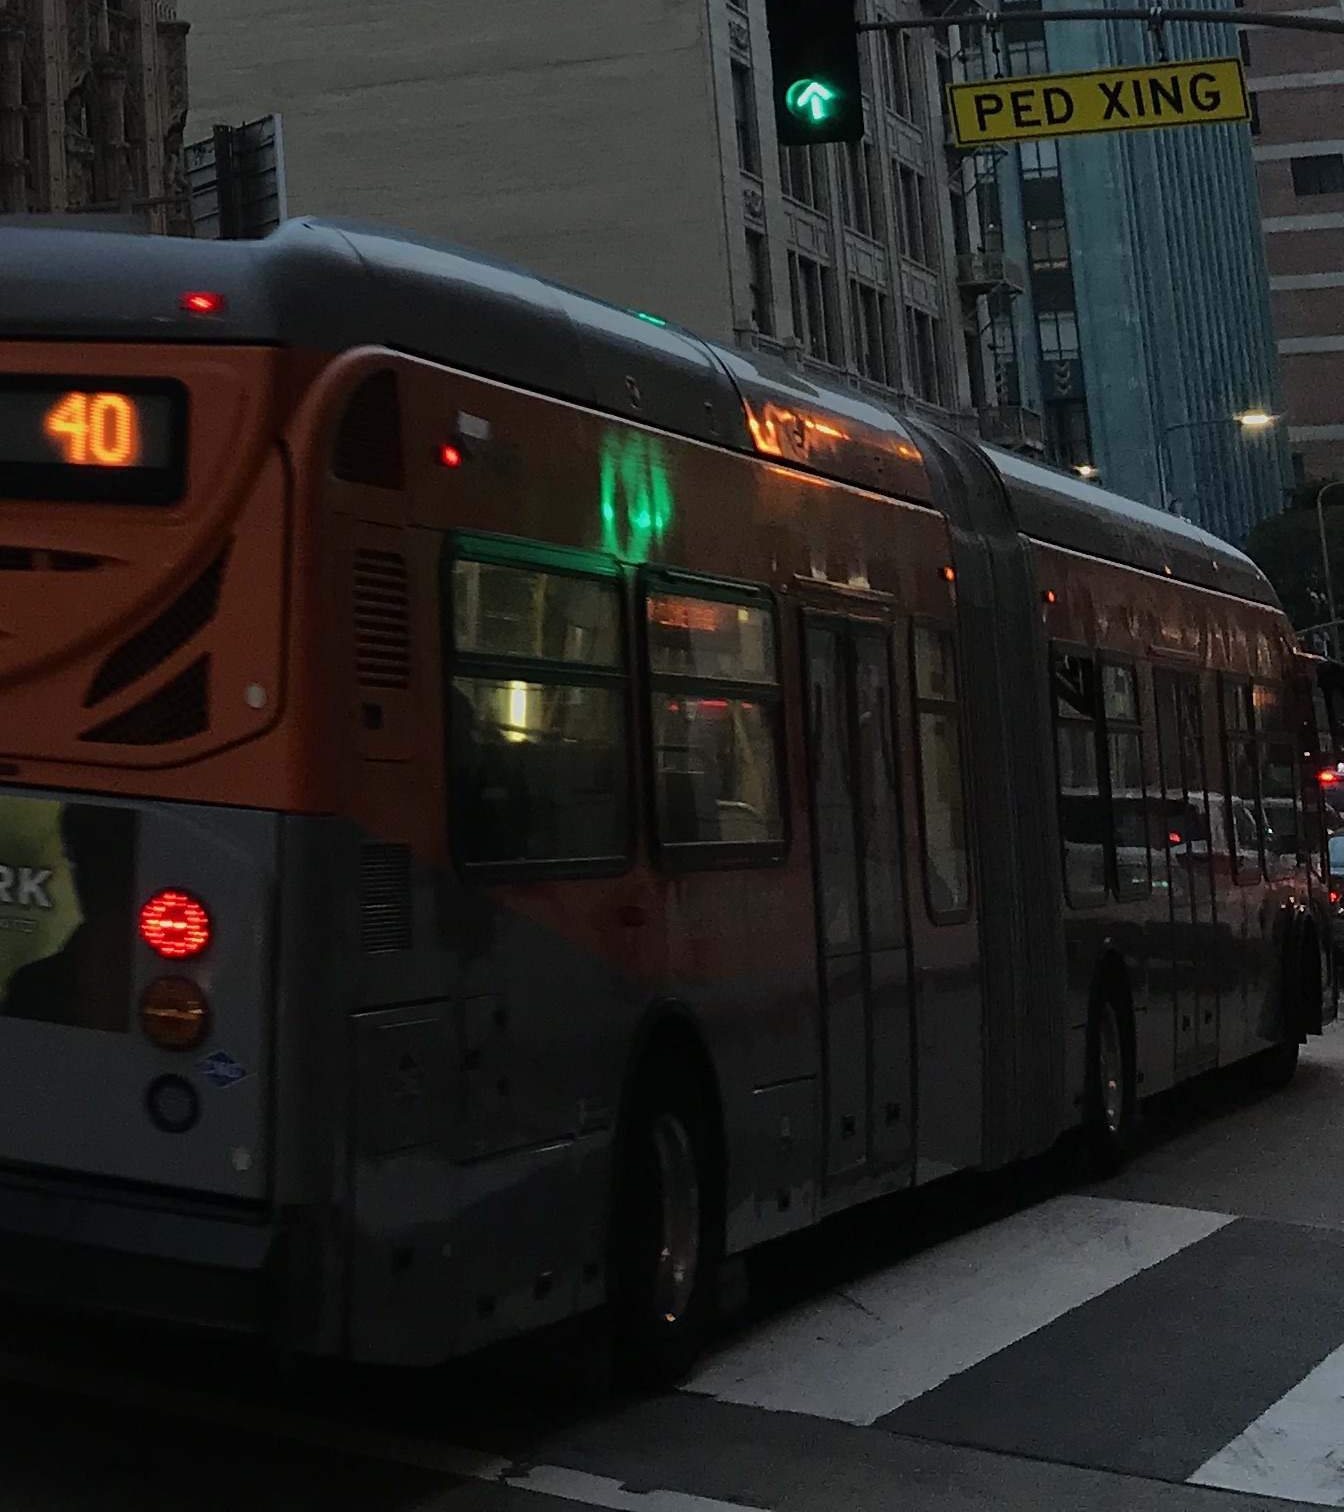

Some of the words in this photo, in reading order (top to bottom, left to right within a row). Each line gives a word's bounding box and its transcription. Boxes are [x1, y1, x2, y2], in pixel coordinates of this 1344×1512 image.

[973, 85, 1076, 132] PED
[1099, 72, 1221, 120] XING
[45, 391, 134, 465] 40
